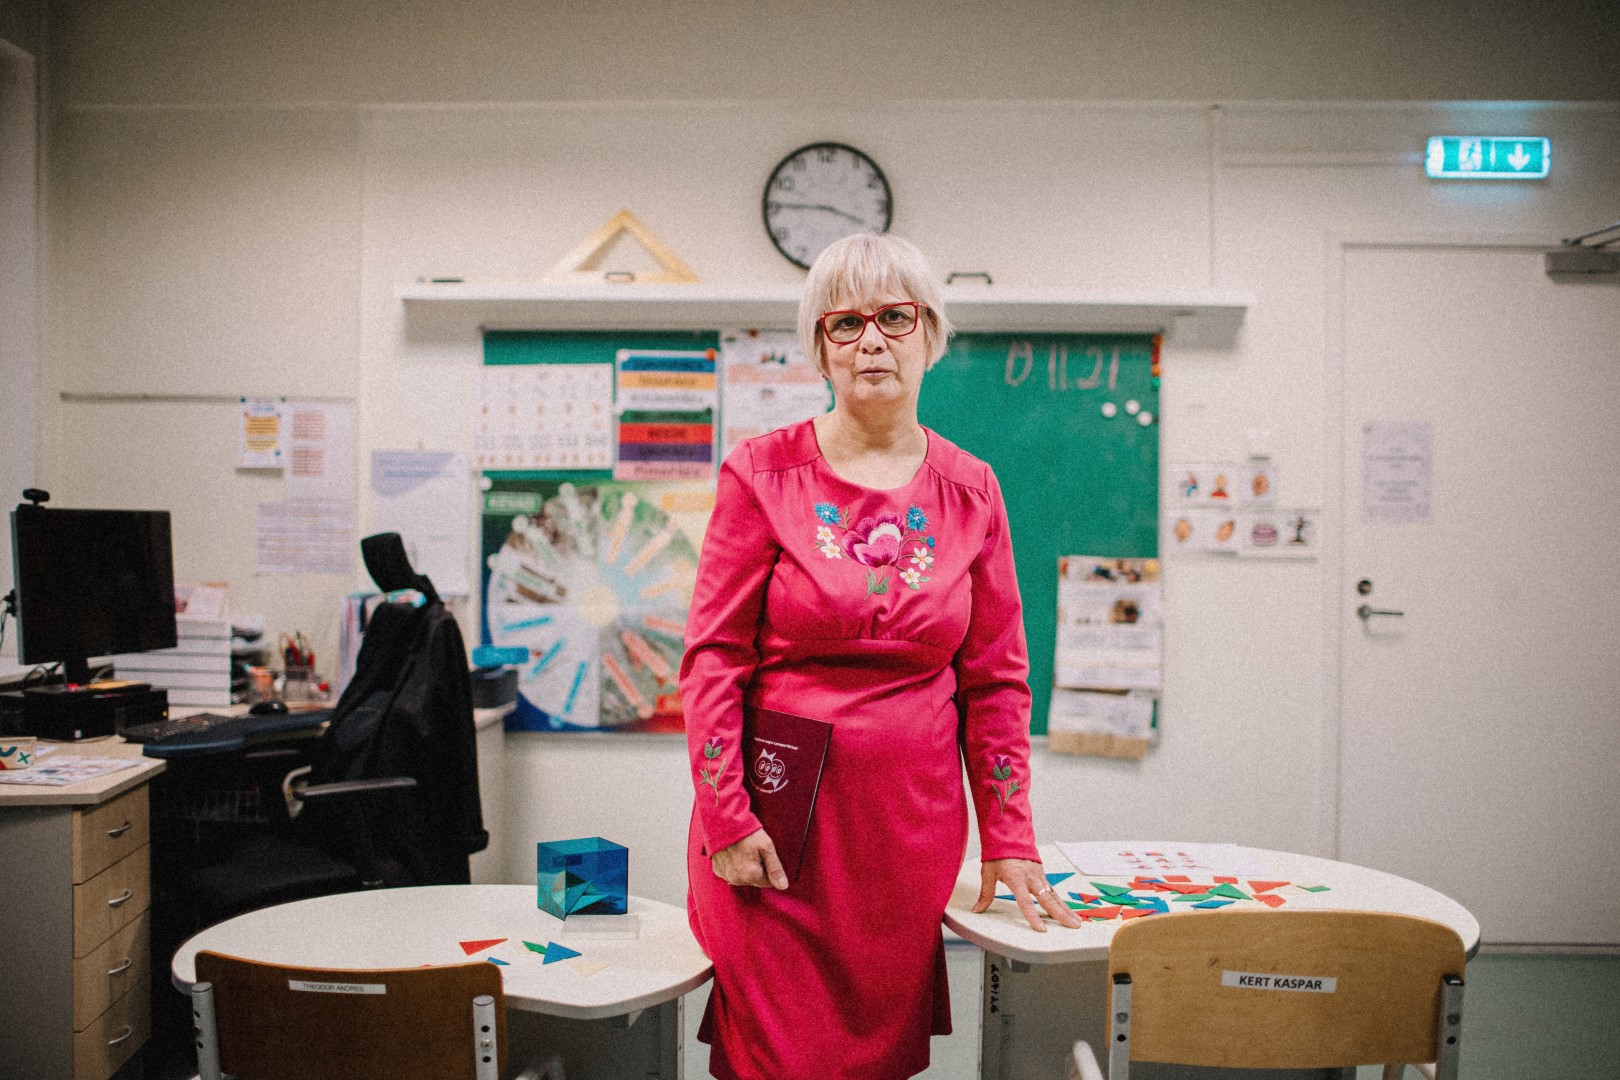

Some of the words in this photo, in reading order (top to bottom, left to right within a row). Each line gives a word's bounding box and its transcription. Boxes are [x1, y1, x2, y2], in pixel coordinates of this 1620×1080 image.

[303, 983, 335, 991] THEODOR
[336, 984, 365, 992] ANDRES
[1239, 975, 1270, 988] KERT
[1273, 978, 1322, 990] KASPAR
